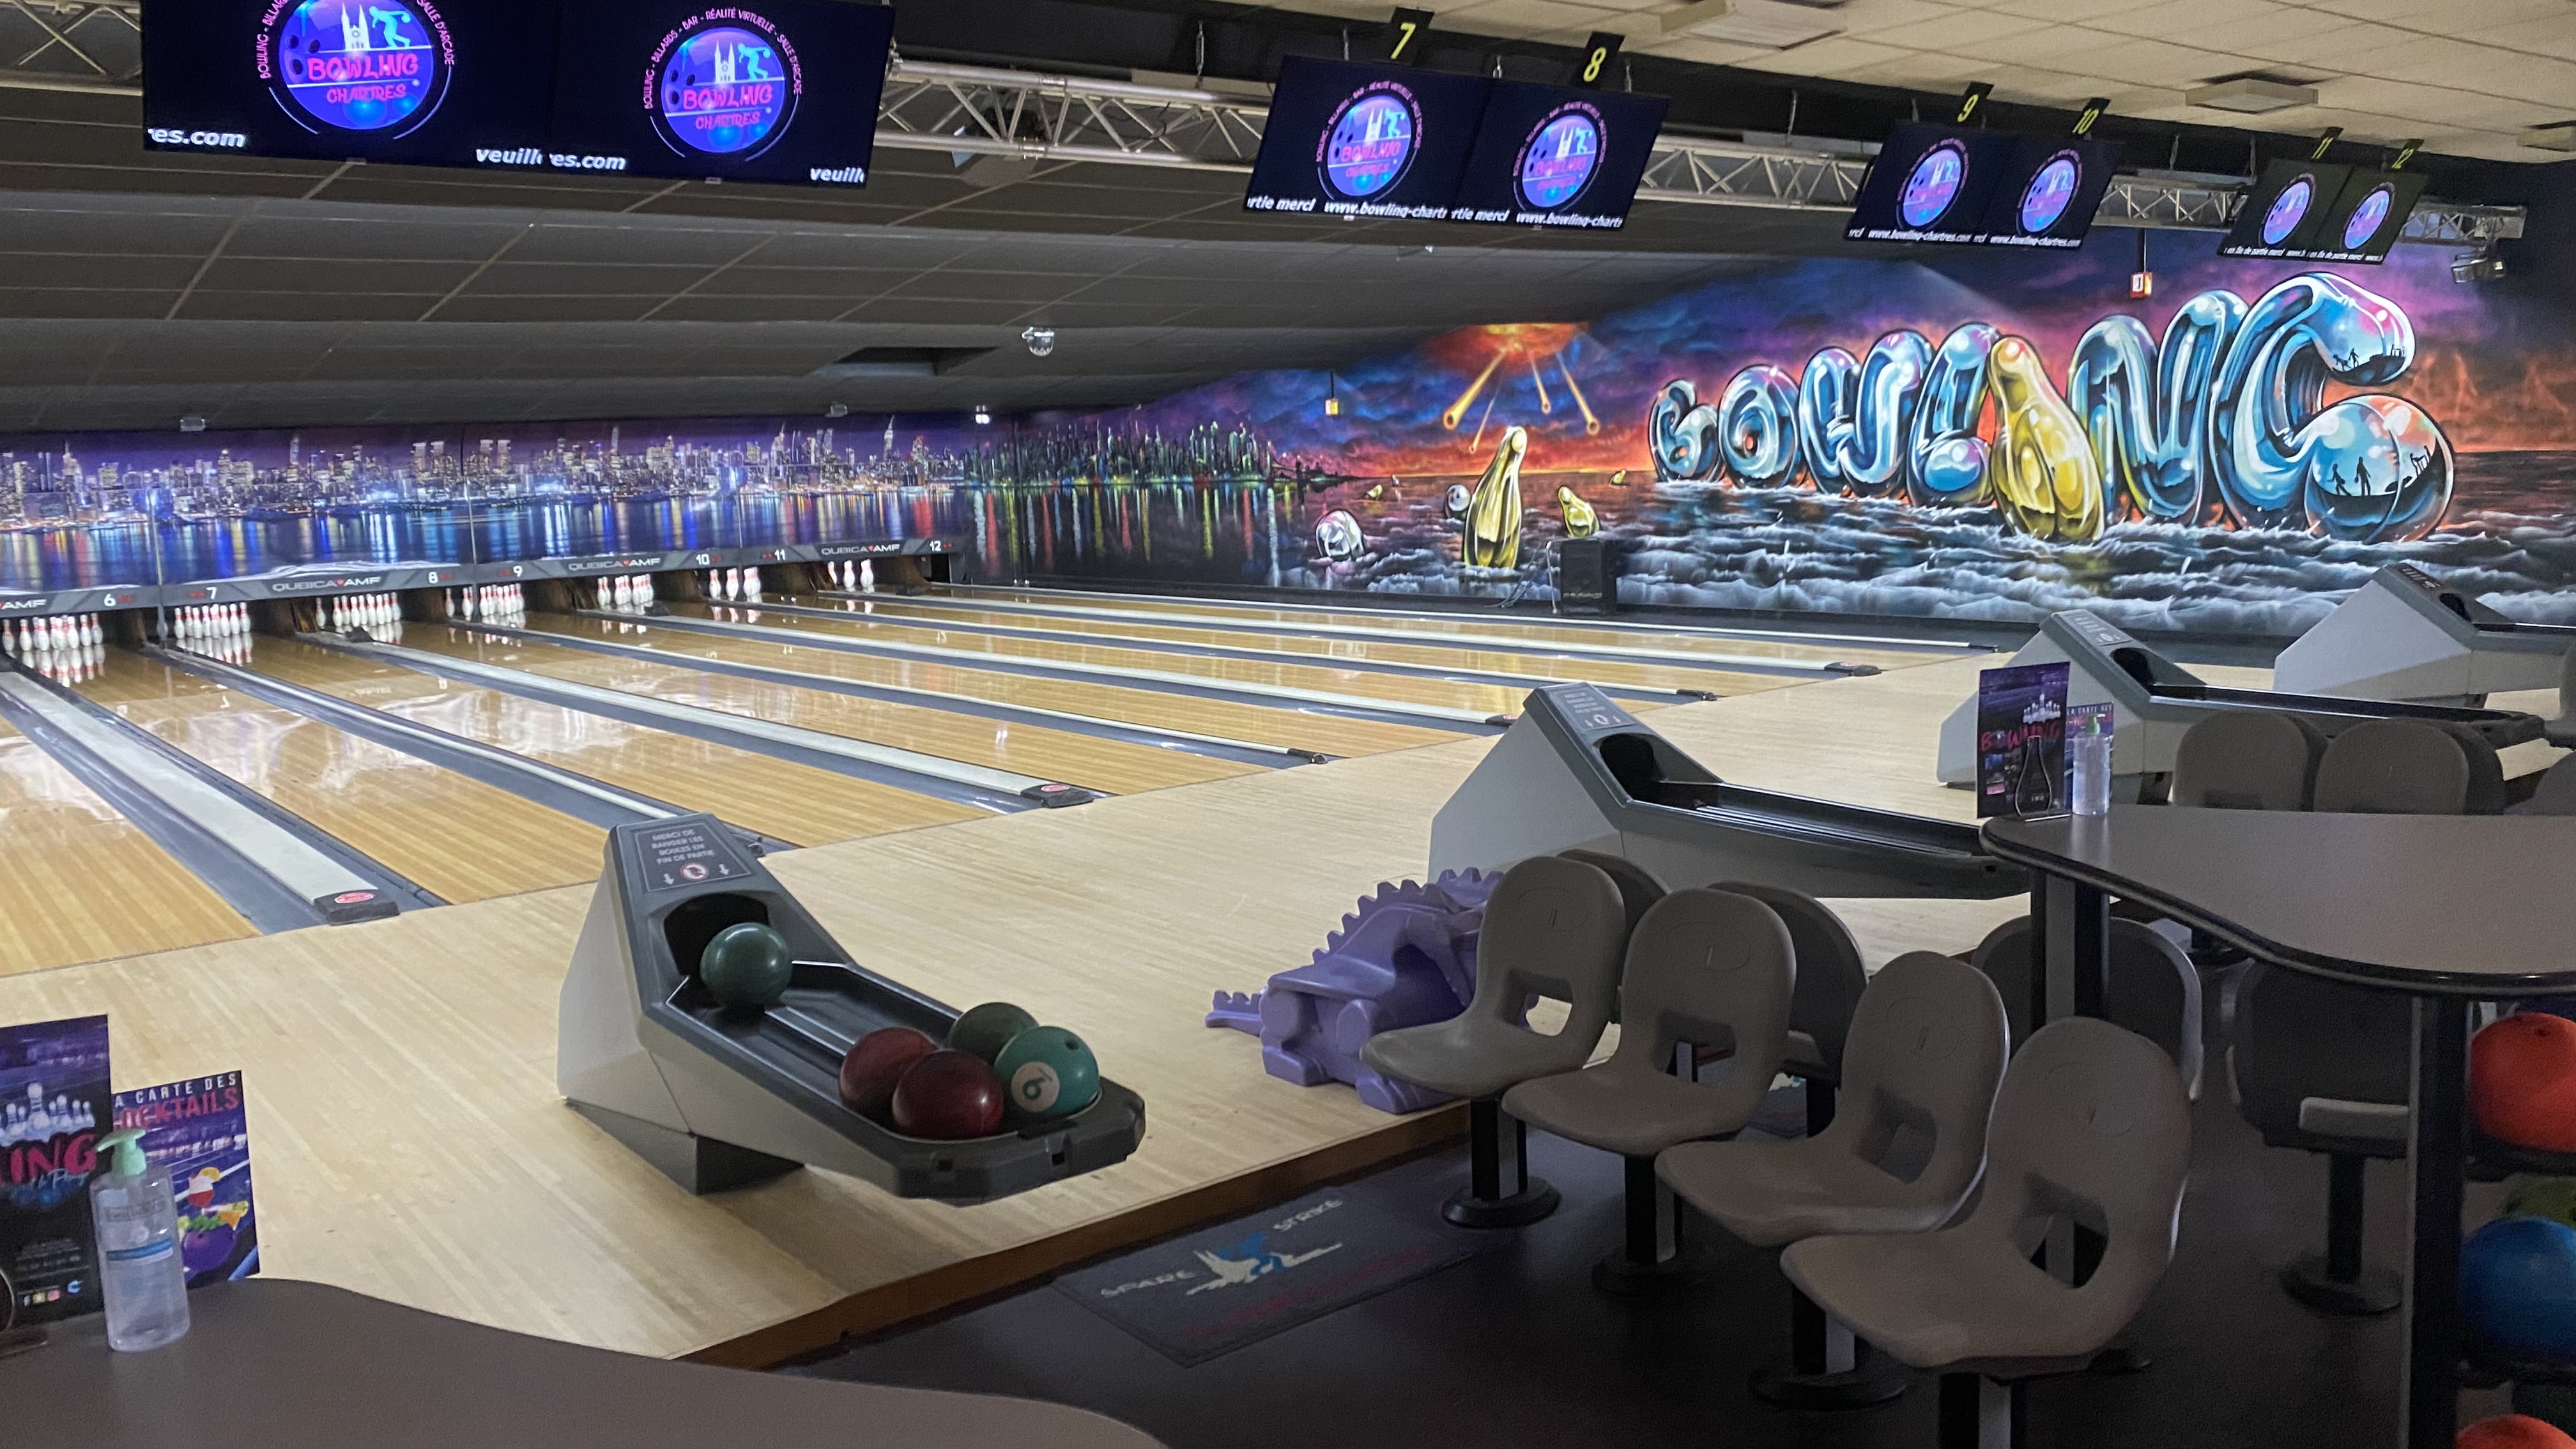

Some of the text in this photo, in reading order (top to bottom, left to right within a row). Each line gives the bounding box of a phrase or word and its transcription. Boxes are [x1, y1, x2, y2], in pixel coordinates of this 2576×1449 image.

[262, 0, 289, 26] BILLAR
[651, 29, 678, 63] BILLARDS
[682, 15, 698, 30] BAR
[1391, 22, 1416, 60] 7
[307, 54, 419, 81] BOWLING
[1583, 47, 1607, 82] 8
[326, 84, 407, 103] CHARTRES
[682, 84, 773, 111] BOWLING
[1957, 94, 1979, 123] 9
[2071, 107, 2099, 135] 10
[148, 128, 246, 148] es.com
[2311, 137, 2334, 159] 11
[549, 153, 627, 171] es.com
[1450, 208, 1474, 220] rtie
[1648, 270, 2455, 544] BOWLING
[774, 549, 786, 561] 11
[871, 544, 900, 552] AMF
[930, 540, 941, 552] 12
[628, 557, 661, 567] AMF
[696, 553, 710, 566] 10
[428, 571, 439, 585] 8
[513, 565, 523, 577] 9
[206, 586, 218, 600] 7
[272, 576, 382, 592] QUBICA AMF
[1, 599, 47, 610] AMF
[103, 594, 116, 607] 6
[115, 1073, 236, 1108] A CARTE DES
[0, 1134, 97, 1185] ING
